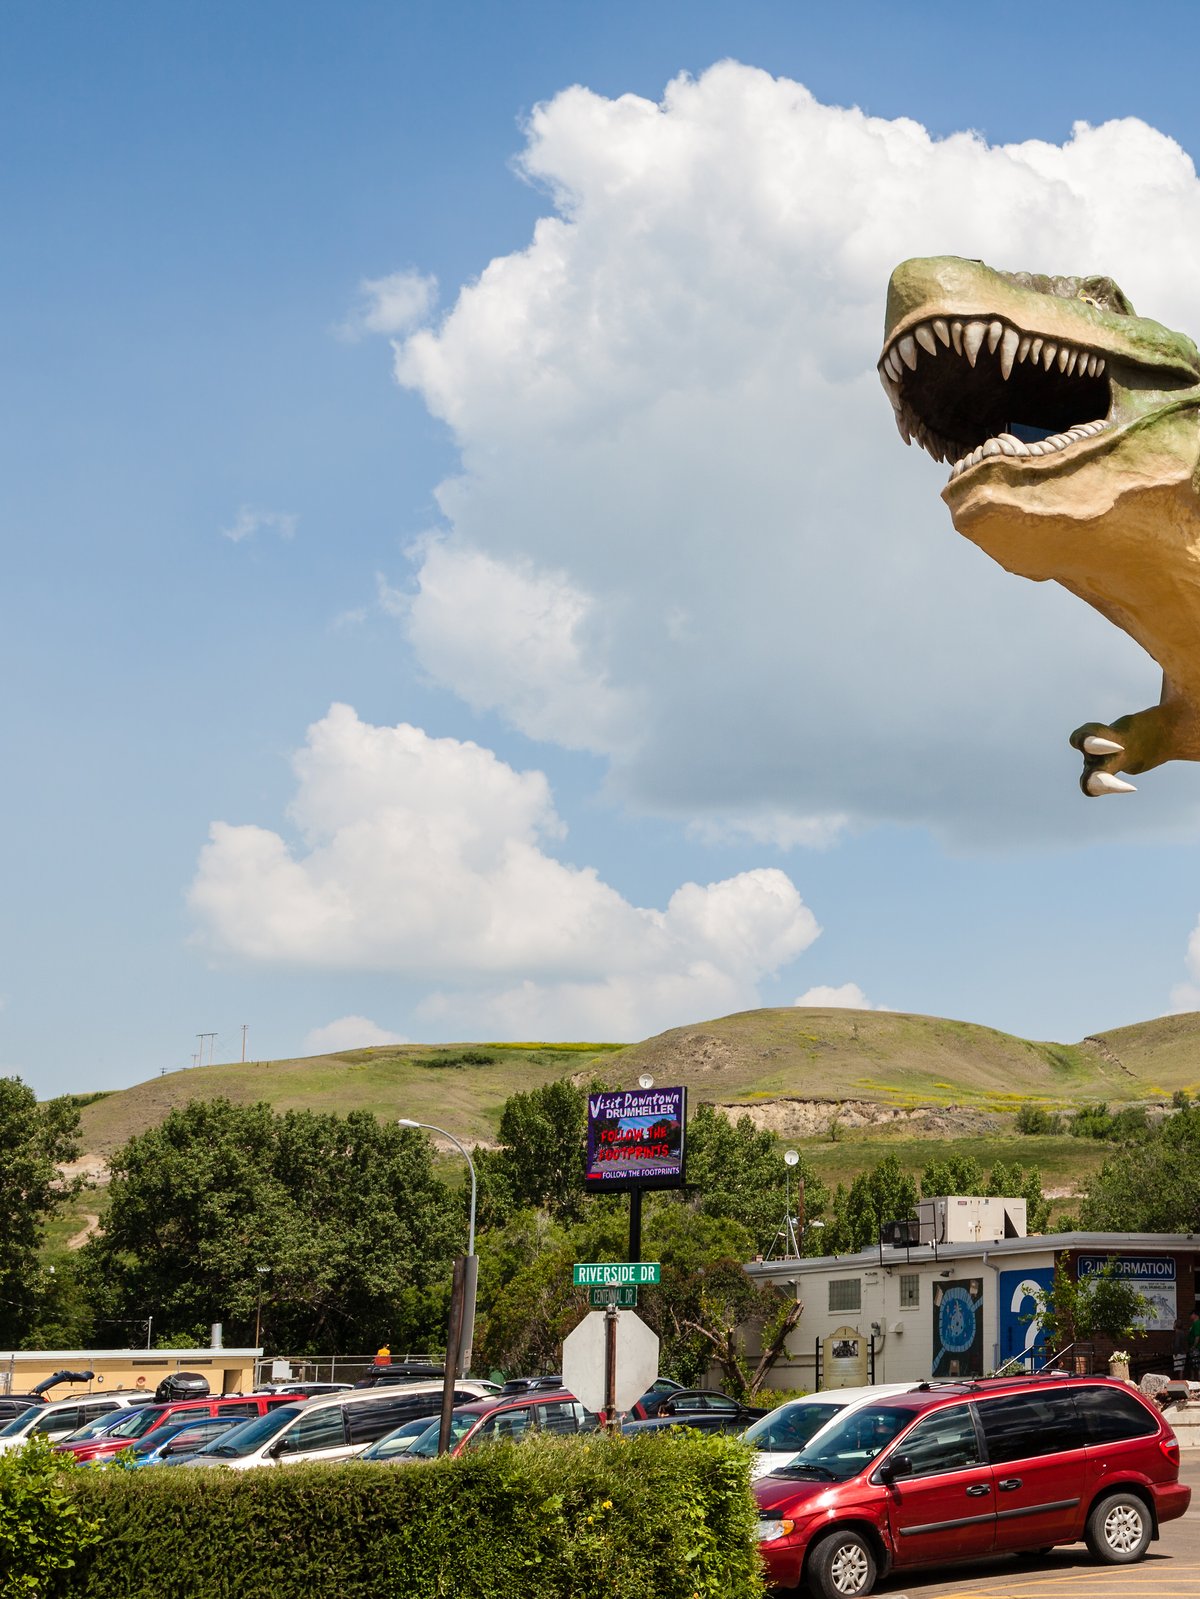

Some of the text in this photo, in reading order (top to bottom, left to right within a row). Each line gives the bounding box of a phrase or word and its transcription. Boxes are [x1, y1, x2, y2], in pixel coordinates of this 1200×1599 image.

[590, 1092, 680, 1118] Visit Downtown
[606, 1104, 675, 1119] DRUMHELLER
[601, 1126, 667, 1142] FOLLOW THE
[597, 1143, 669, 1162] FOOTPRINTS
[602, 1171, 627, 1179] FOLLOW
[641, 1167, 680, 1176] FOOTPRINTS
[579, 1266, 655, 1282] RIVERSIDE DR
[1096, 1262, 1173, 1275] INFORMATION
[593, 1289, 633, 1304] CENTENNIAL DR
